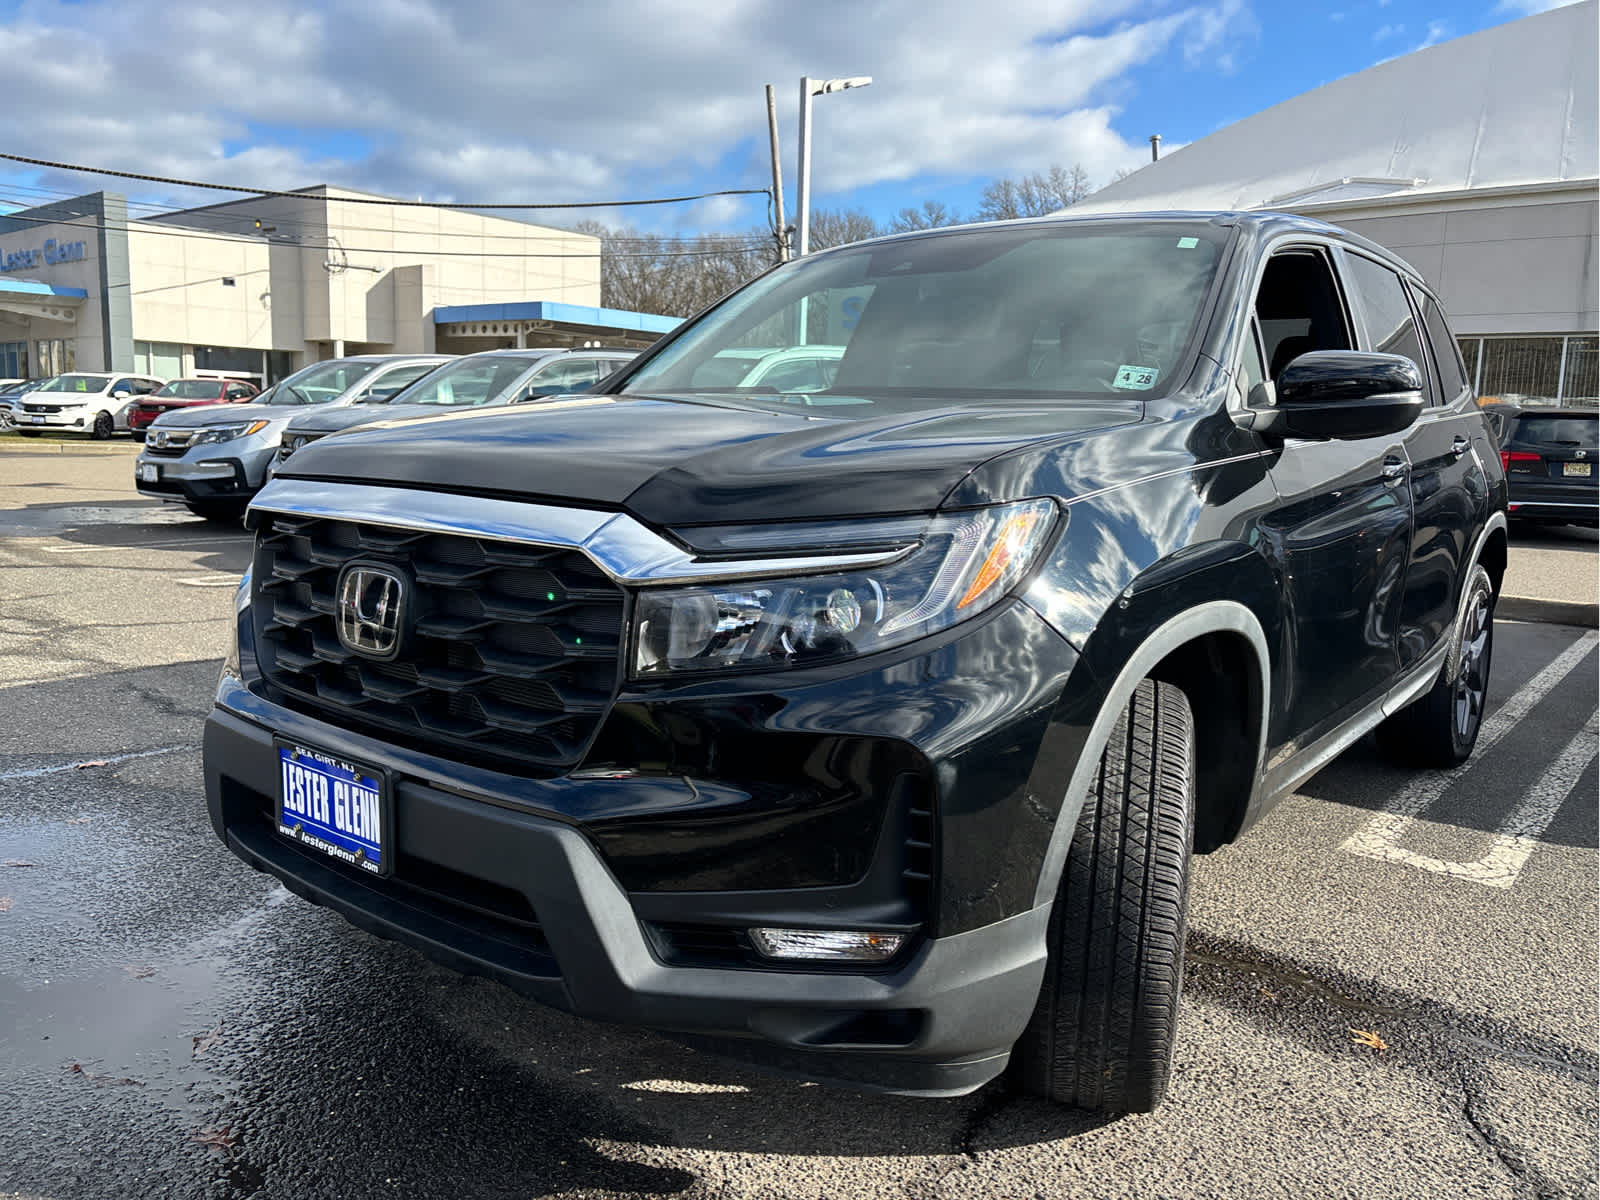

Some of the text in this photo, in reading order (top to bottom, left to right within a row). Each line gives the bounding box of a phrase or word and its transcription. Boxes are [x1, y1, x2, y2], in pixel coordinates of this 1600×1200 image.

[0, 239, 84, 272] Lester Glenn
[1122, 372, 1152, 384] 4 28
[295, 746, 313, 759] SEA
[341, 761, 355, 773] NJ
[282, 761, 381, 844] LESTER GLENN
